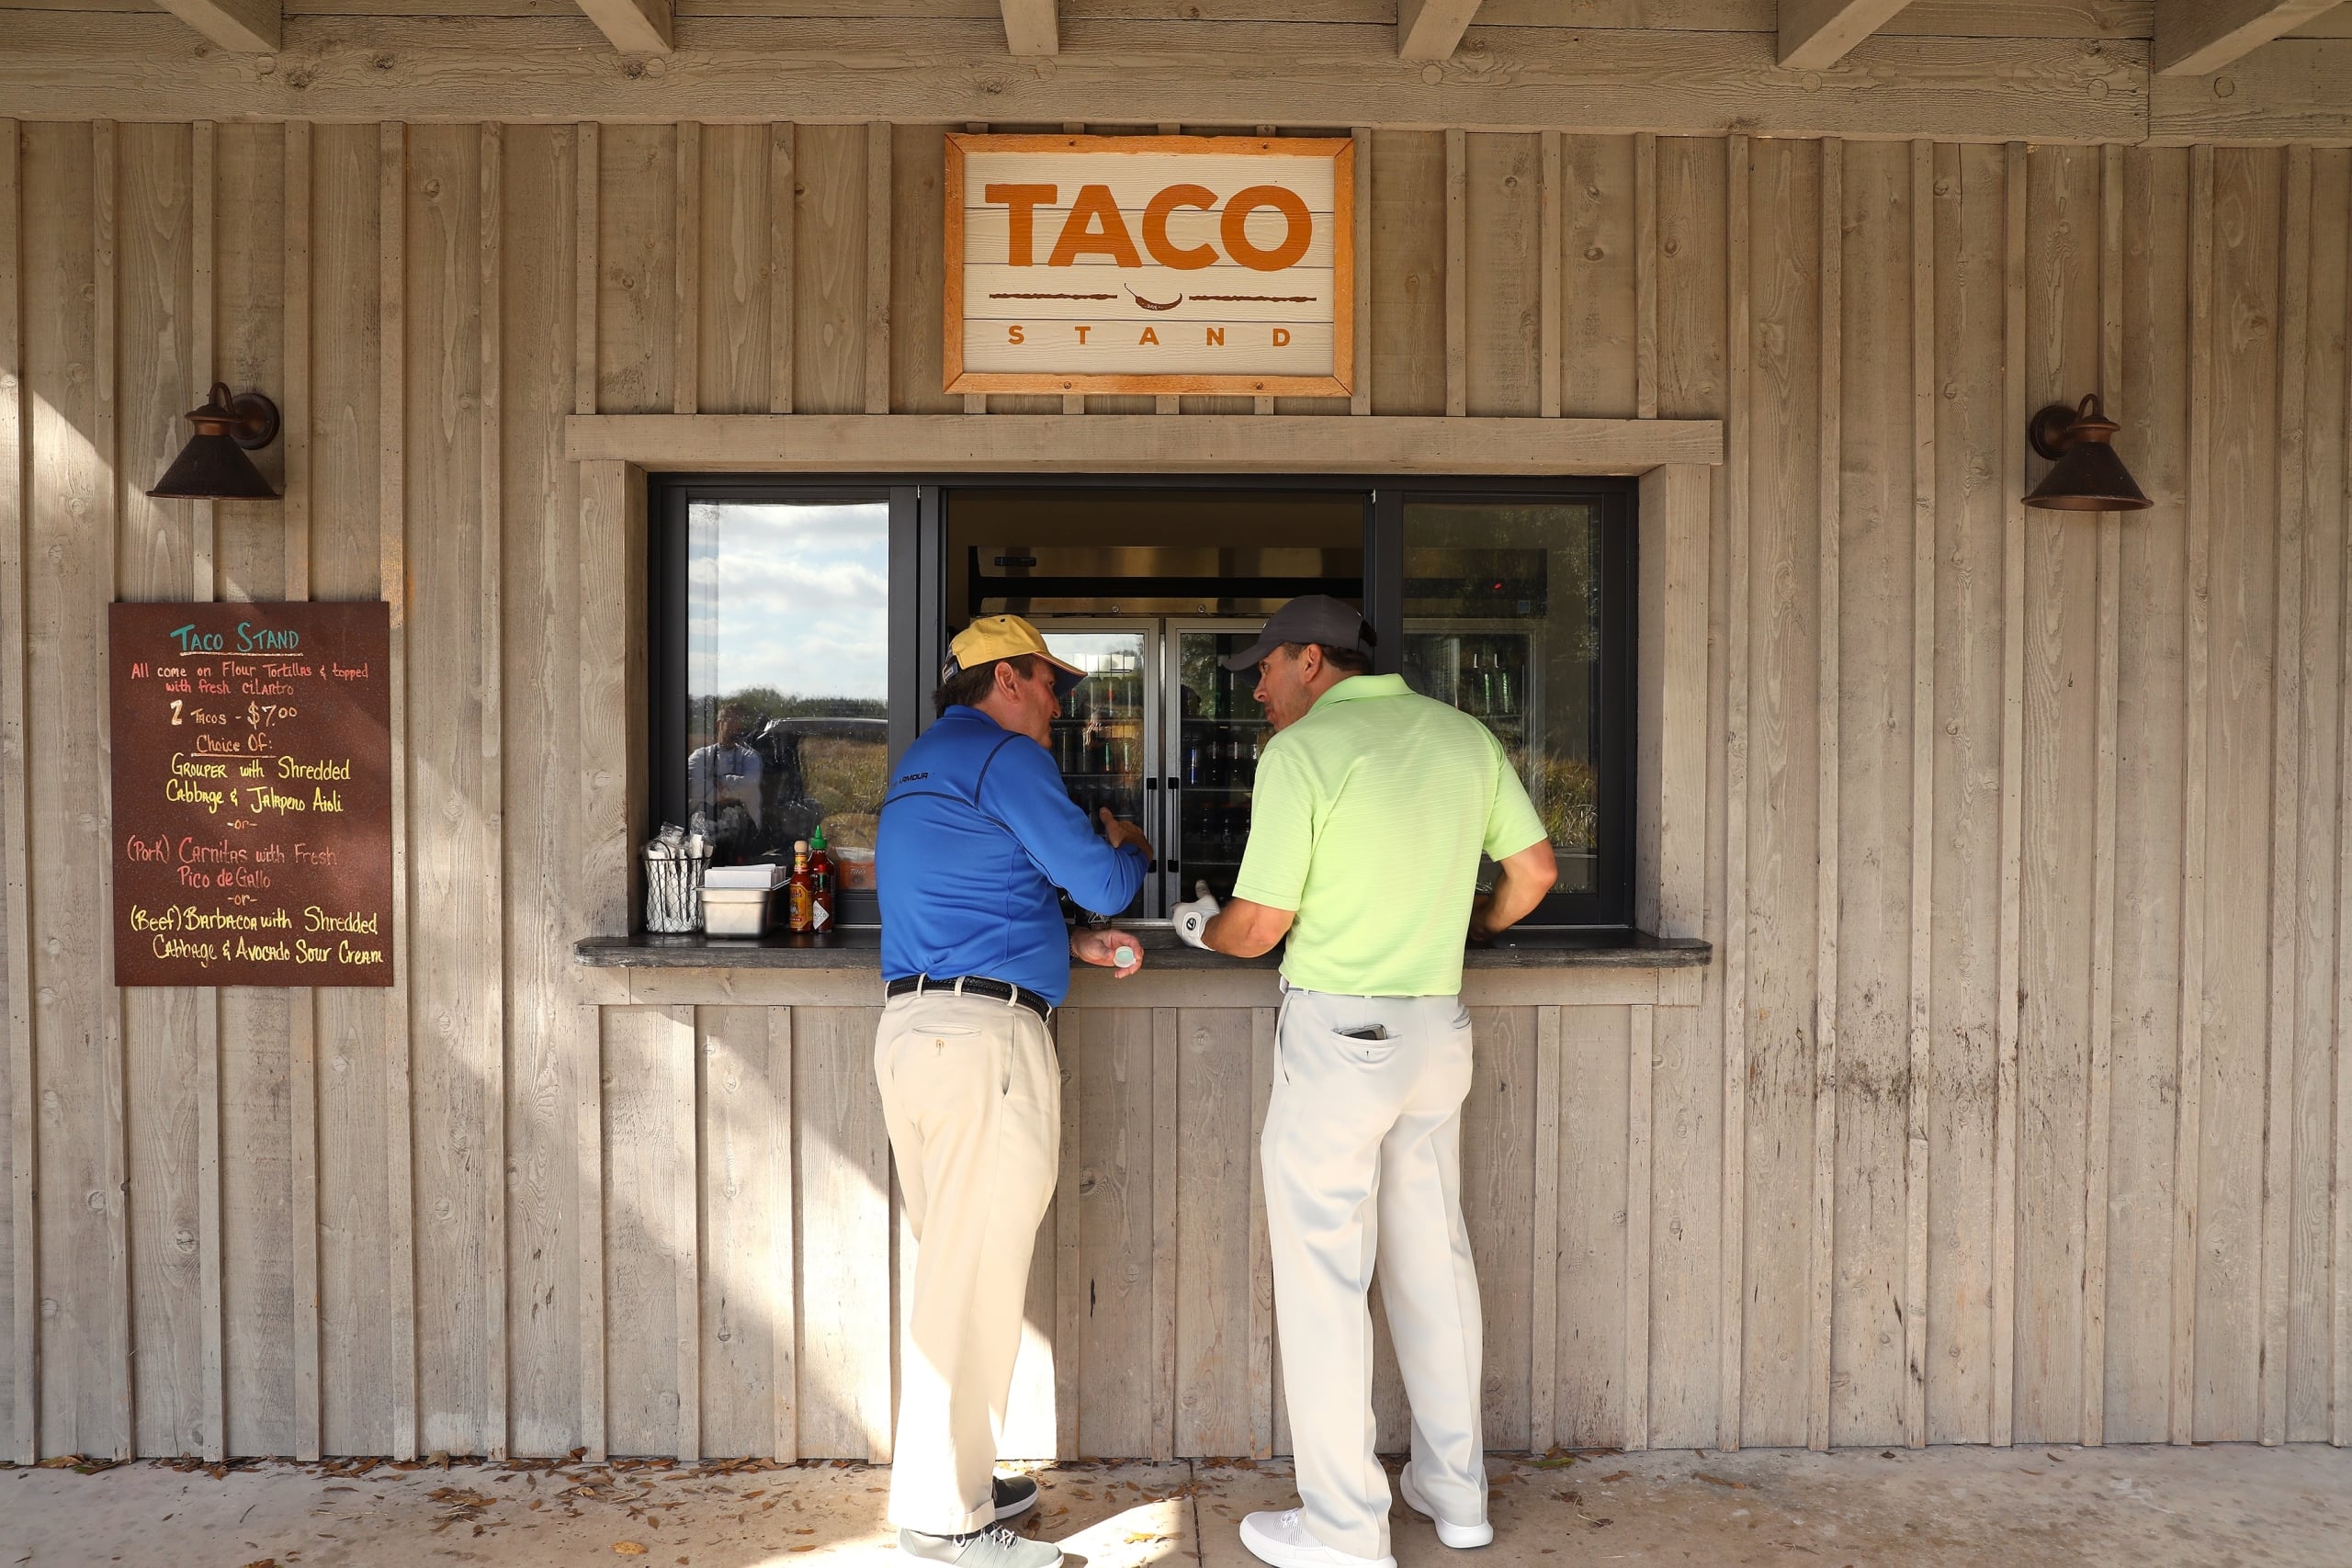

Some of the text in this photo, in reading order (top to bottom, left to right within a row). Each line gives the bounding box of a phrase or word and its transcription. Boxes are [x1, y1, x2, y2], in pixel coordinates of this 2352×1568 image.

[985, 184, 1313, 272] TACO
[1008, 325, 1291, 347] STAND
[131, 662, 149, 680] All
[157, 666, 187, 678] come
[197, 666, 211, 678] on
[222, 660, 256, 678] Flour
[320, 664, 327, 680] &
[333, 662, 368, 681] topped
[165, 680, 192, 694] with
[198, 679, 232, 694] fresh
[169, 699, 183, 726] 2
[196, 733, 273, 753] Choice Of:
[239, 759, 265, 778] with
[277, 755, 351, 781] Shredded
[165, 778, 344, 816] Cabbage & Jalapeno Aioli
[178, 837, 248, 864] Carnitas
[255, 841, 285, 864] with
[294, 842, 337, 866] Fresh
[176, 865, 271, 888] Pico de Gallo
[130, 904, 379, 935] (Beef) Barbacoa with Shredded
[153, 933, 383, 968] Cabbage & Avocado Sour Cream
